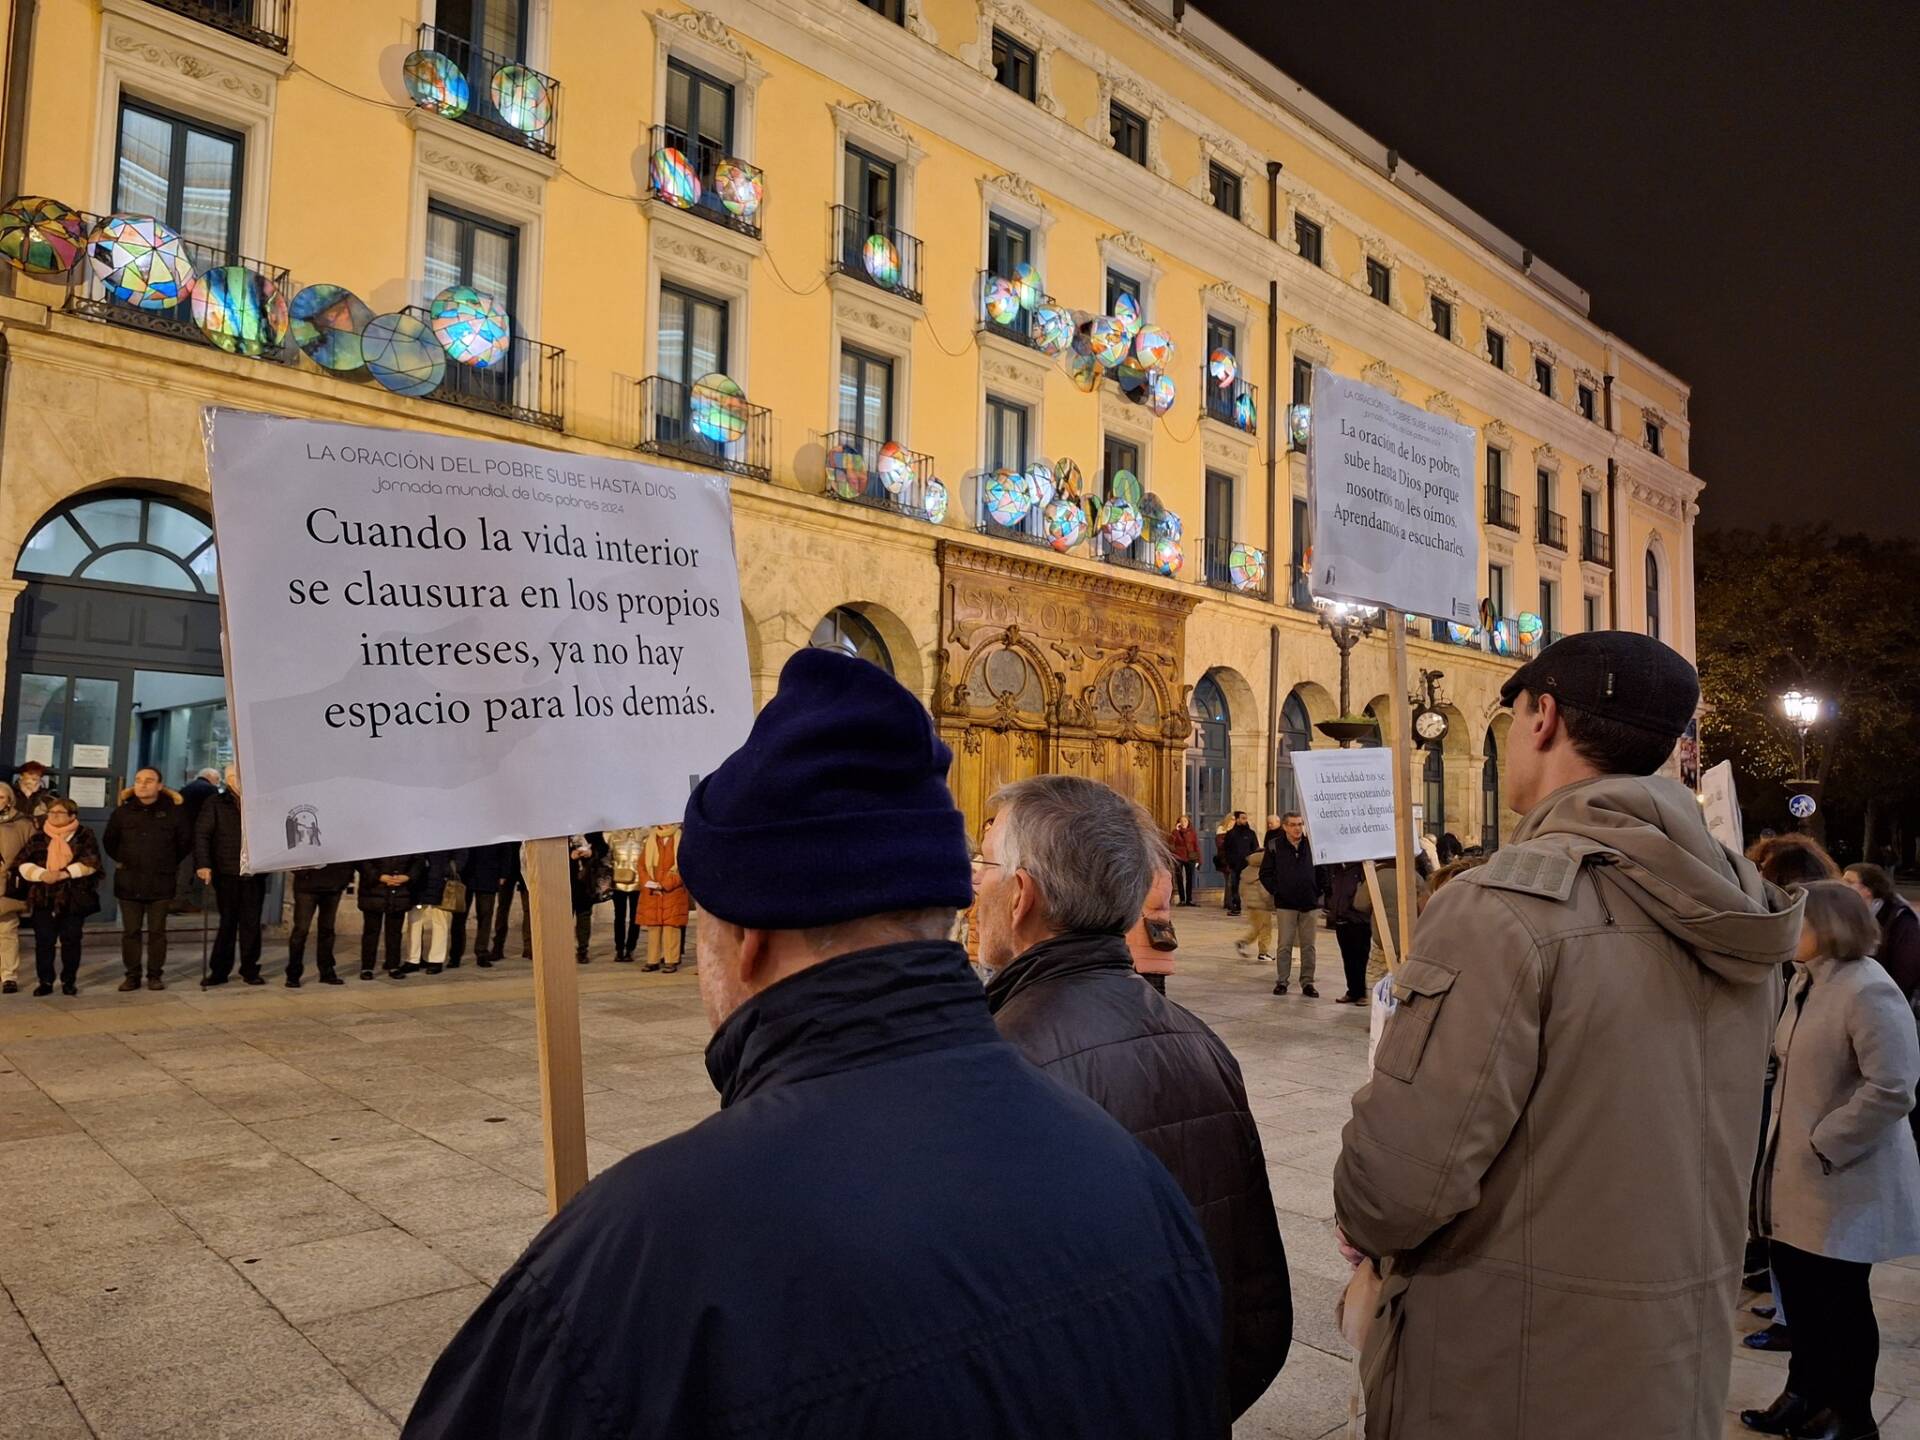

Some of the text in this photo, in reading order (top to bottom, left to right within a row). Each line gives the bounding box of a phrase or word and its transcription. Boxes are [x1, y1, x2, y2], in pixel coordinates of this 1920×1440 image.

[306, 443, 678, 501] LA ORACIÓN DEL POBRE SUBE HASTA DIOS
[1341, 418, 1356, 438] La
[1397, 441, 1409, 460] de
[1411, 446, 1427, 466] los
[1429, 457, 1461, 479] pobres
[445, 483, 510, 498] mundial
[511, 485, 530, 500] de
[532, 487, 554, 503] los
[555, 494, 600, 509] pobres
[601, 502, 625, 514] 2024
[1344, 451, 1371, 472] sube
[1399, 468, 1422, 492] Dios
[1424, 480, 1460, 504] porque
[1346, 480, 1393, 505] nosotros
[1407, 499, 1421, 518] les
[306, 507, 700, 568] Cuando la vida interior
[1333, 503, 1400, 538] Aprendamos
[288, 570, 720, 626] se clausura en los propios
[360, 632, 685, 676] intereses, ya no hay
[324, 685, 716, 739] espacio para los demás.
